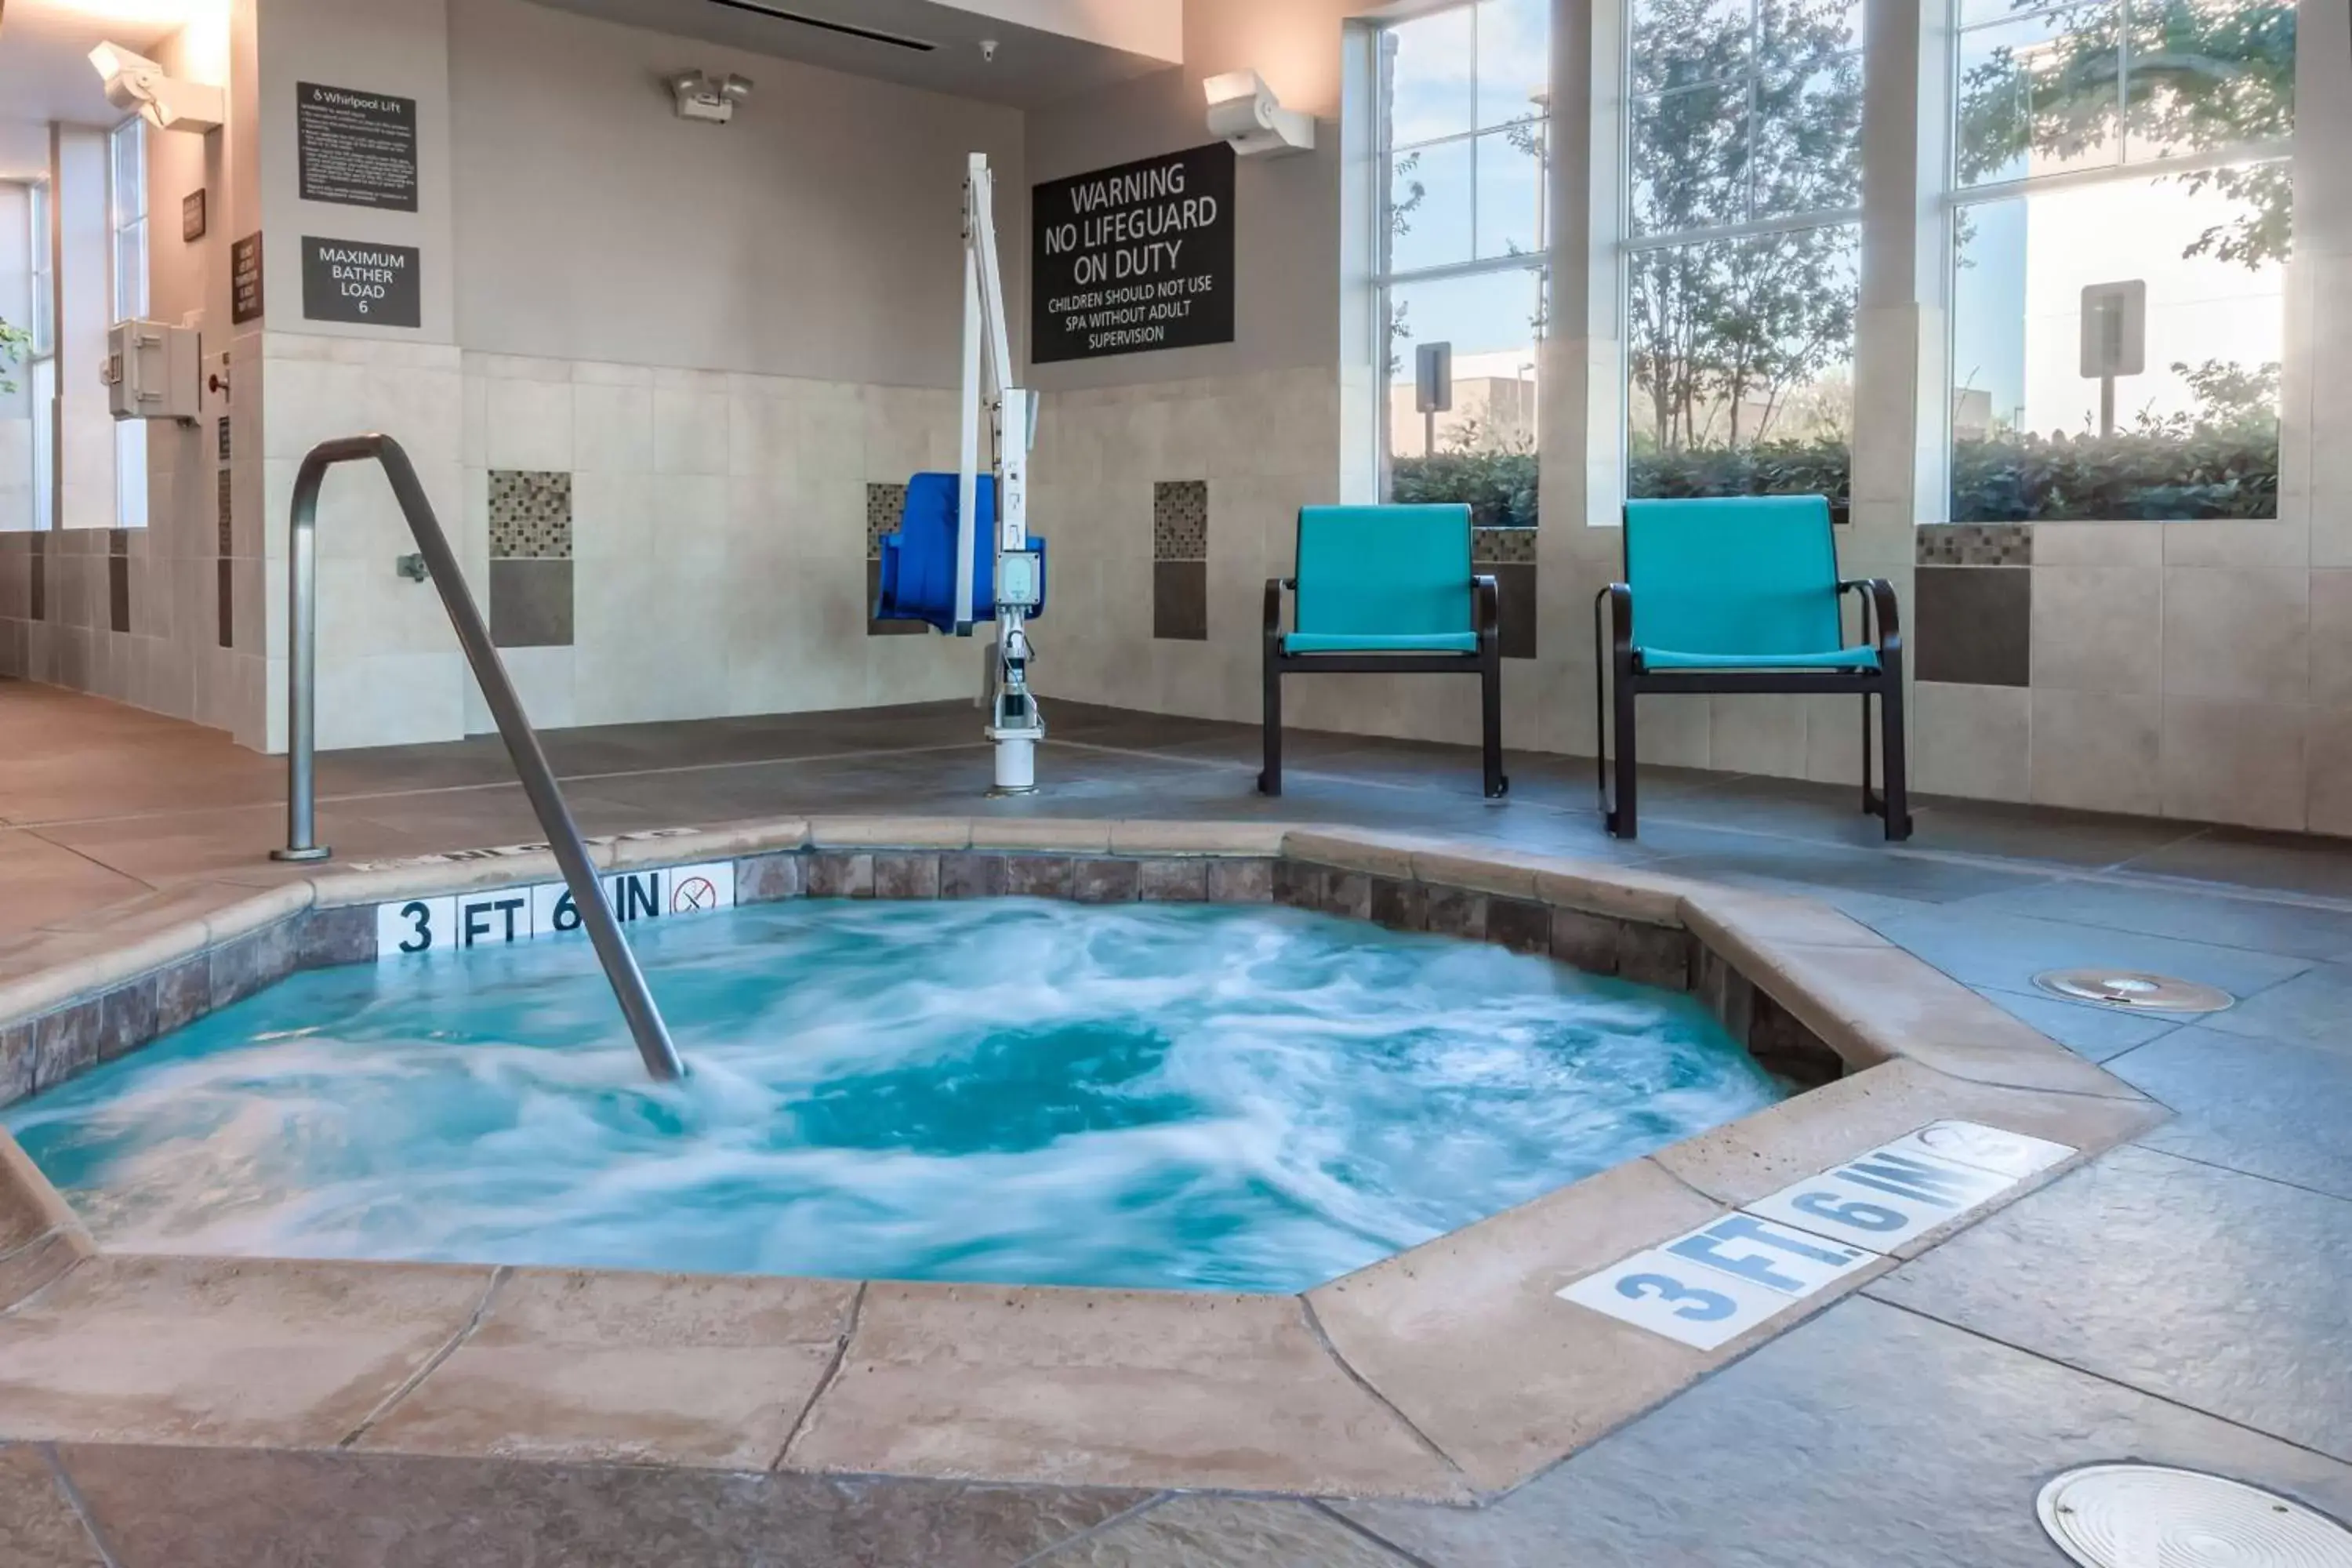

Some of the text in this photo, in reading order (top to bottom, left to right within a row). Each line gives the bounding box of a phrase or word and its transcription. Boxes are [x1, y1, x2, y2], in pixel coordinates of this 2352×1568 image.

[325, 92, 378, 109] Whirlpool
[382, 100, 401, 114] Lift
[1070, 163, 1185, 213] WARNING
[1045, 196, 1216, 256] NO LIFEGUARD
[318, 246, 405, 268] MAXIMUM
[332, 264, 394, 283] BATHER
[1074, 239, 1183, 285] ON DUTY
[340, 281, 385, 299] LOAD
[358, 300, 368, 314] 6
[1048, 275, 1213, 314] CHILDREN SHOULD NOT USE
[1065, 299, 1192, 332] SPA WITHOUT ADULT
[1089, 325, 1165, 350] SUPERVISION
[398, 872, 659, 953] 3 FT 6 IN
[1832, 1150, 1962, 1210] IN
[1791, 1191, 1910, 1233] 6
[1614, 1272, 1738, 1323] 3
